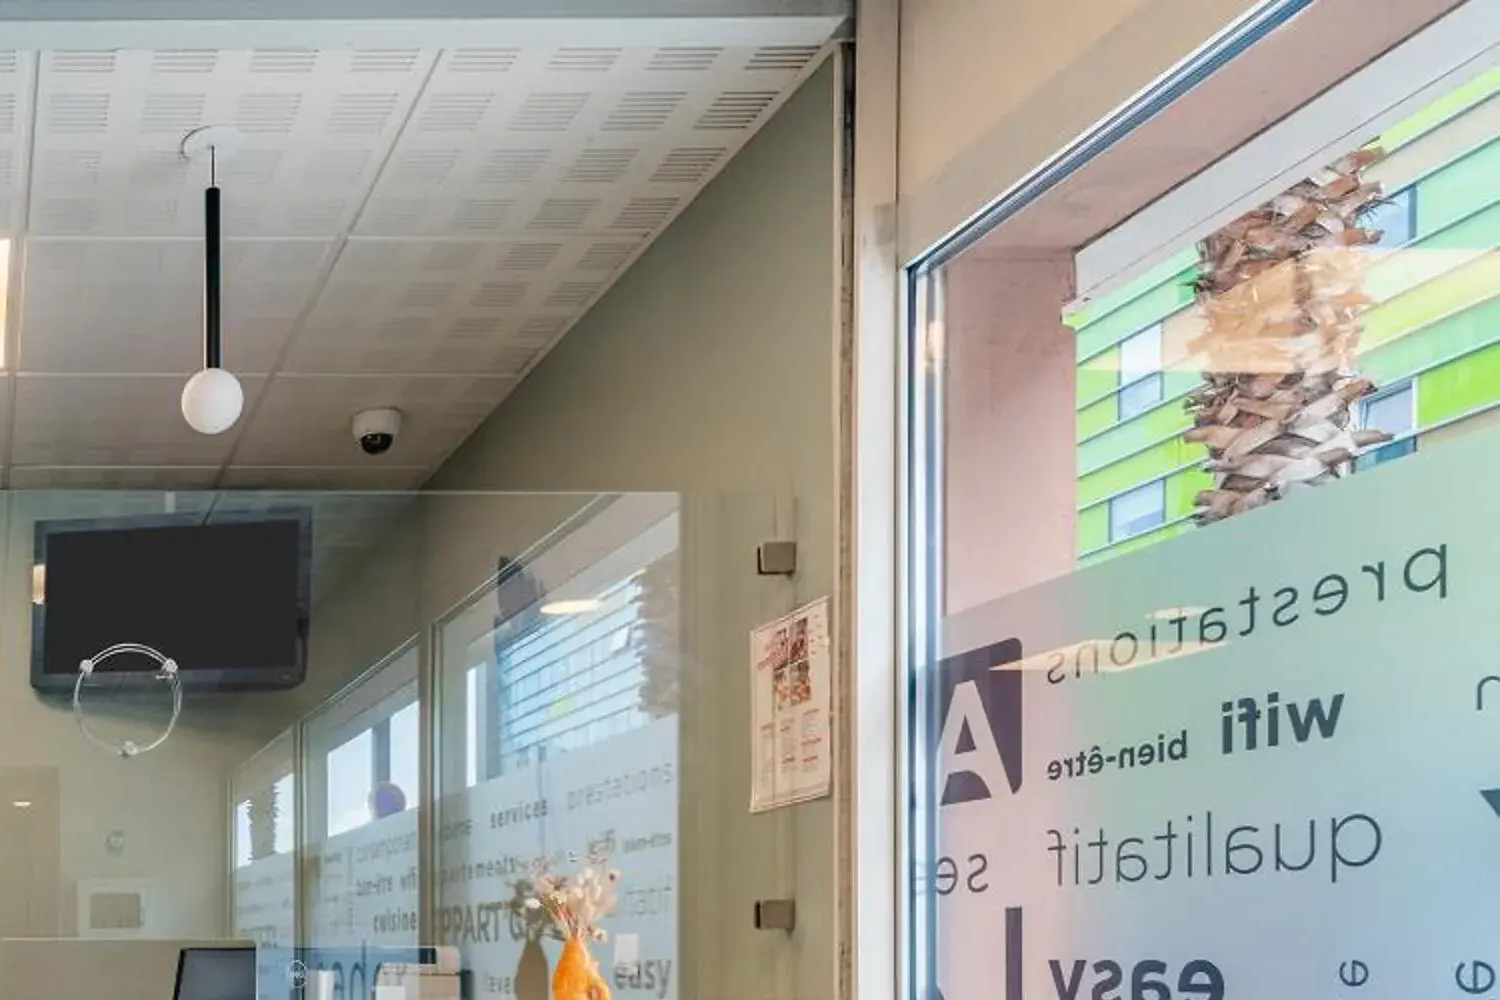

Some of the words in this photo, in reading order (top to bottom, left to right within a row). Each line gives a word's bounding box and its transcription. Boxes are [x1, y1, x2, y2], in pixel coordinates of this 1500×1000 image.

[490, 799, 548, 829] services
[373, 903, 418, 933] cuisine
[614, 960, 673, 998] easy
